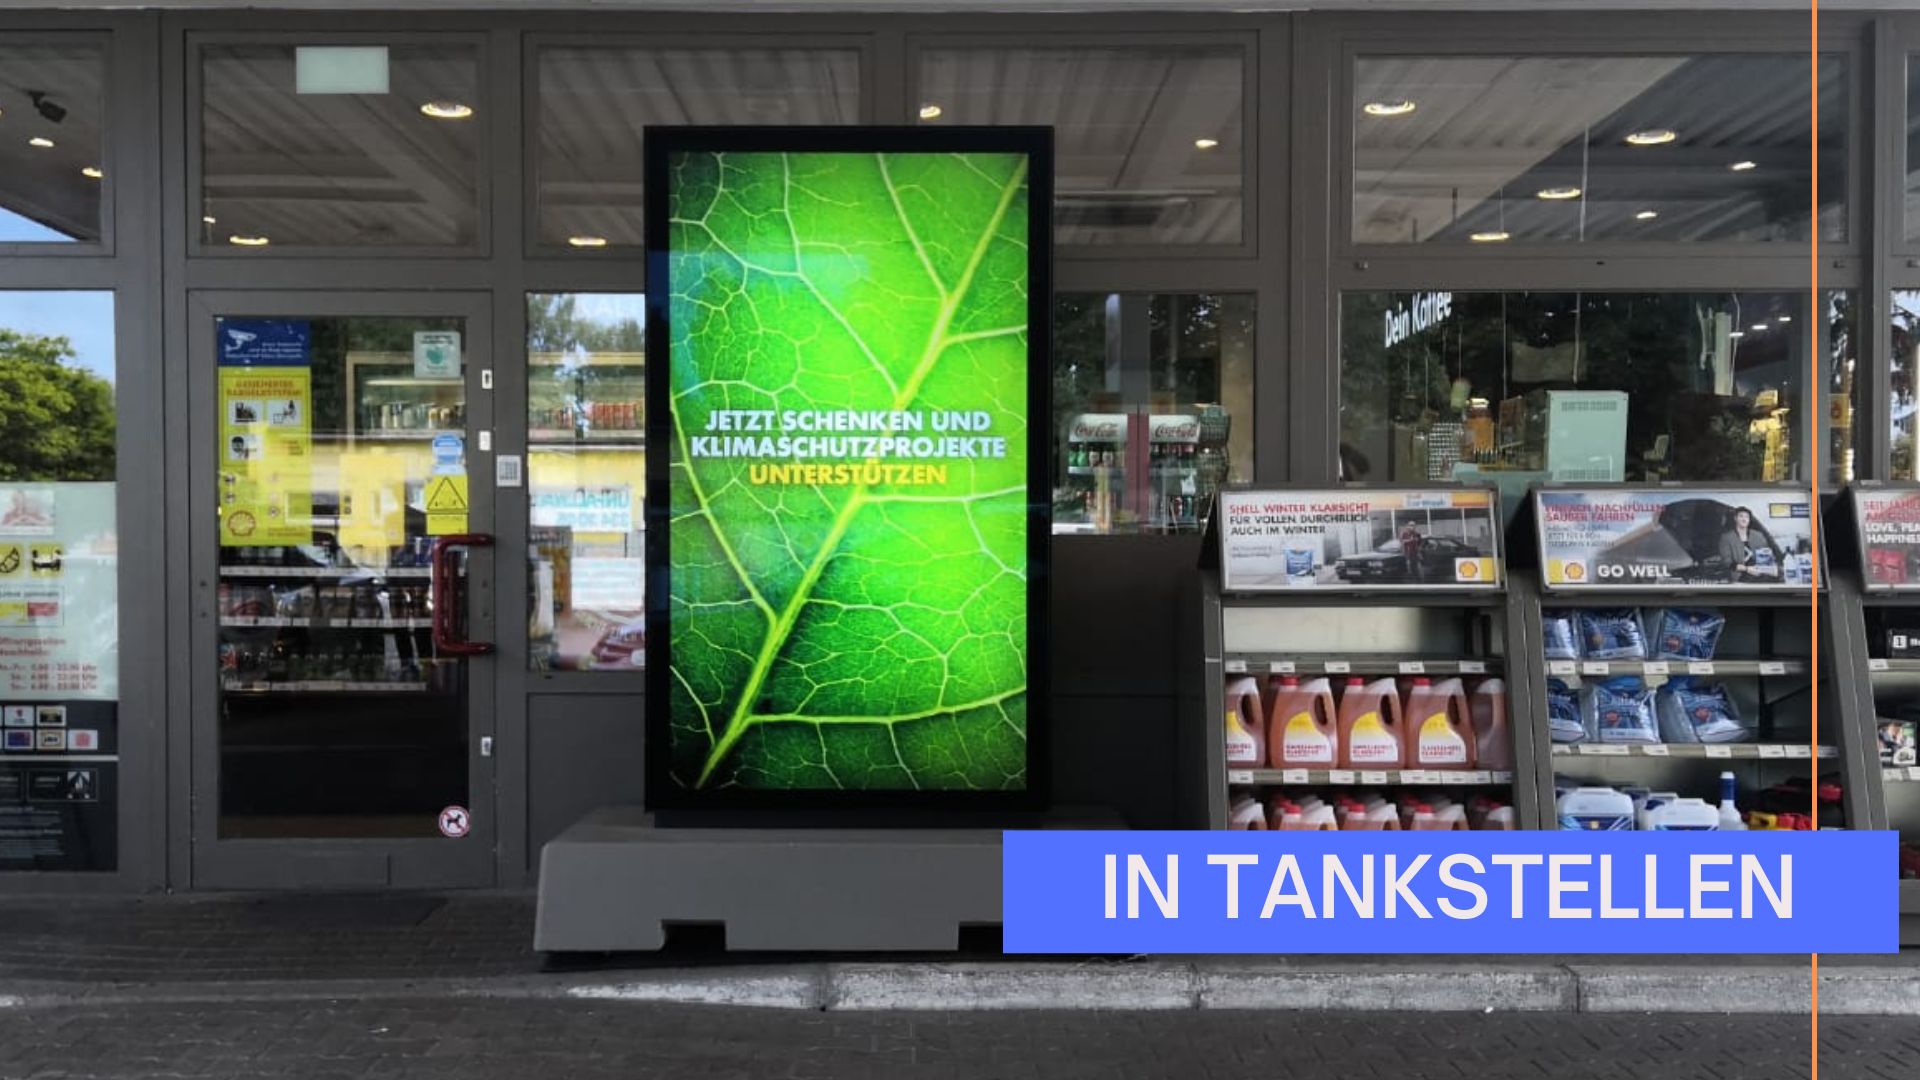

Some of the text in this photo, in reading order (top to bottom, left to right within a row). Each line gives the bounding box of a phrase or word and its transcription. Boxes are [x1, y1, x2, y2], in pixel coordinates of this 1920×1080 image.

[1385, 301, 1410, 348] Dein
[705, 410, 991, 432] JETZT SCHENKEN UND
[691, 436, 1006, 458] KLIMASCHUTZPROJEKTE
[750, 461, 947, 485] UNTERSTÜTZEN
[1229, 502, 1370, 514] SHELL WINTER KLARSICHT
[1229, 514, 1250, 525] FÜR
[1254, 515, 1296, 524] VOLLEN
[1300, 513, 1369, 524] DURCHBLICK
[1231, 525, 1326, 536] AUCH IM WINTER
[1597, 564, 1672, 578] GO WELL
